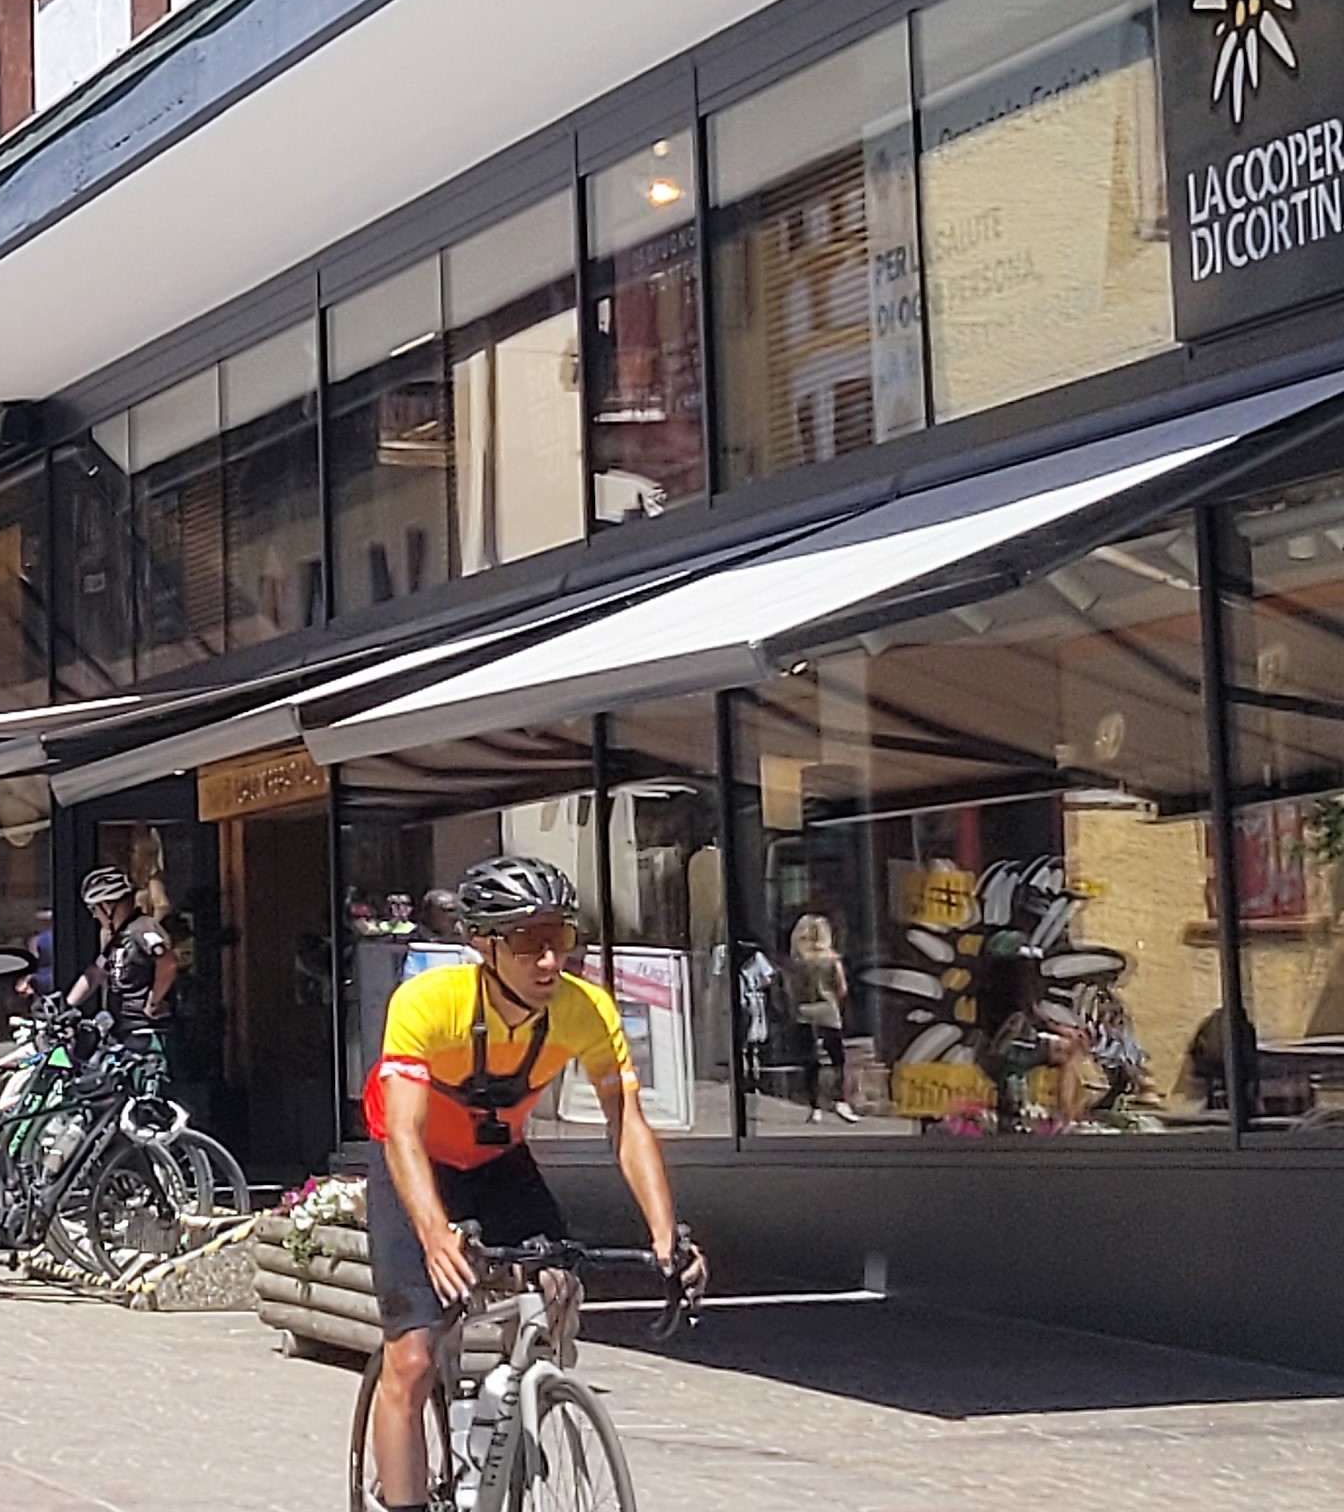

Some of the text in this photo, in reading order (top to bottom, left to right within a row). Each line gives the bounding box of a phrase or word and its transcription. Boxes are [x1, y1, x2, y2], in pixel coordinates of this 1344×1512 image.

[1187, 118, 1344, 225] LA COOPER
[1190, 178, 1344, 281] DI CORTIN
[874, 246, 908, 286] PER
[877, 303, 896, 336] DI
